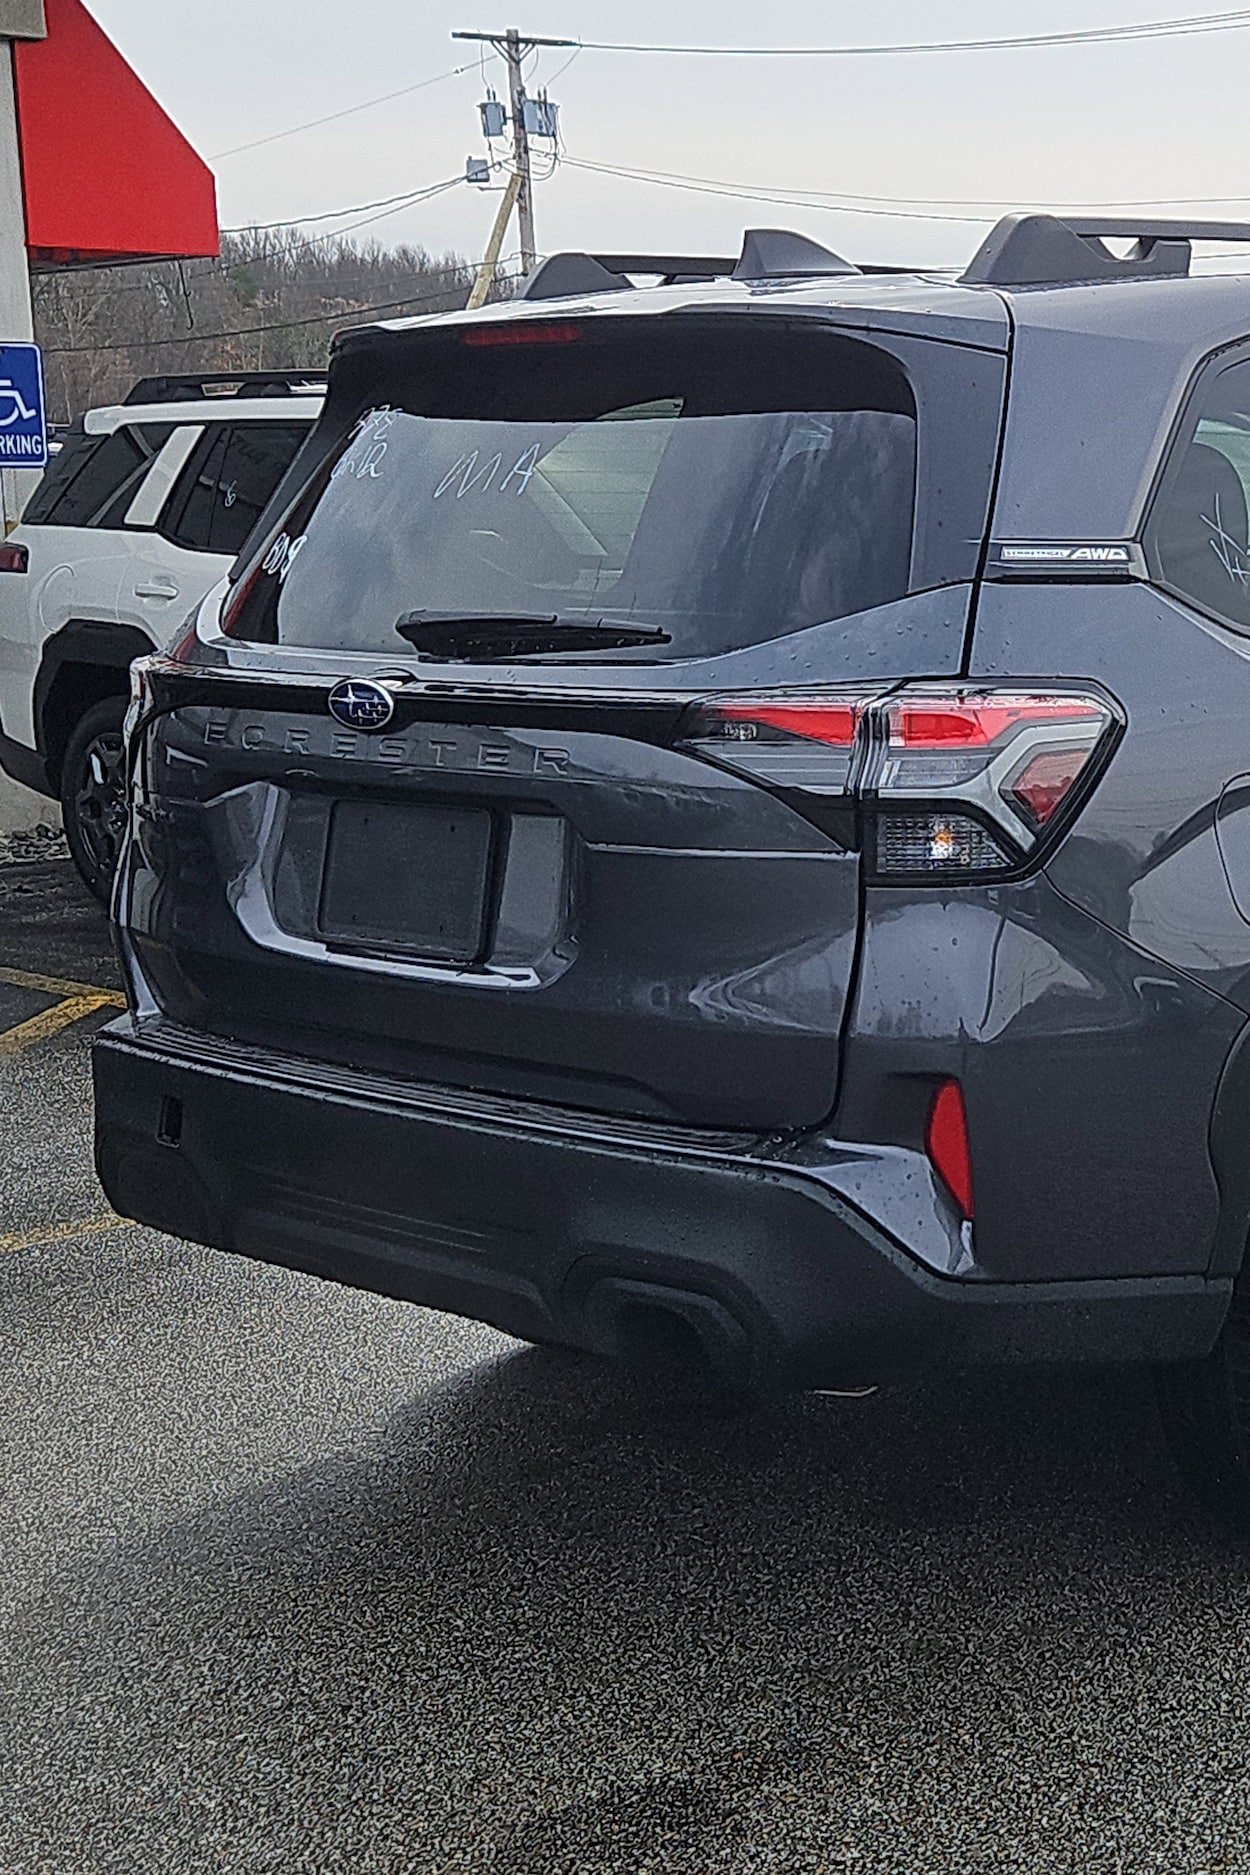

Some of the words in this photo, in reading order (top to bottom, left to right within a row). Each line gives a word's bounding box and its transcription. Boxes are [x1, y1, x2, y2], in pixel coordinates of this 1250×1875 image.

[433, 442, 541, 498] MA
[1070, 547, 1130, 560] AWD
[204, 721, 573, 776] FORESTER
